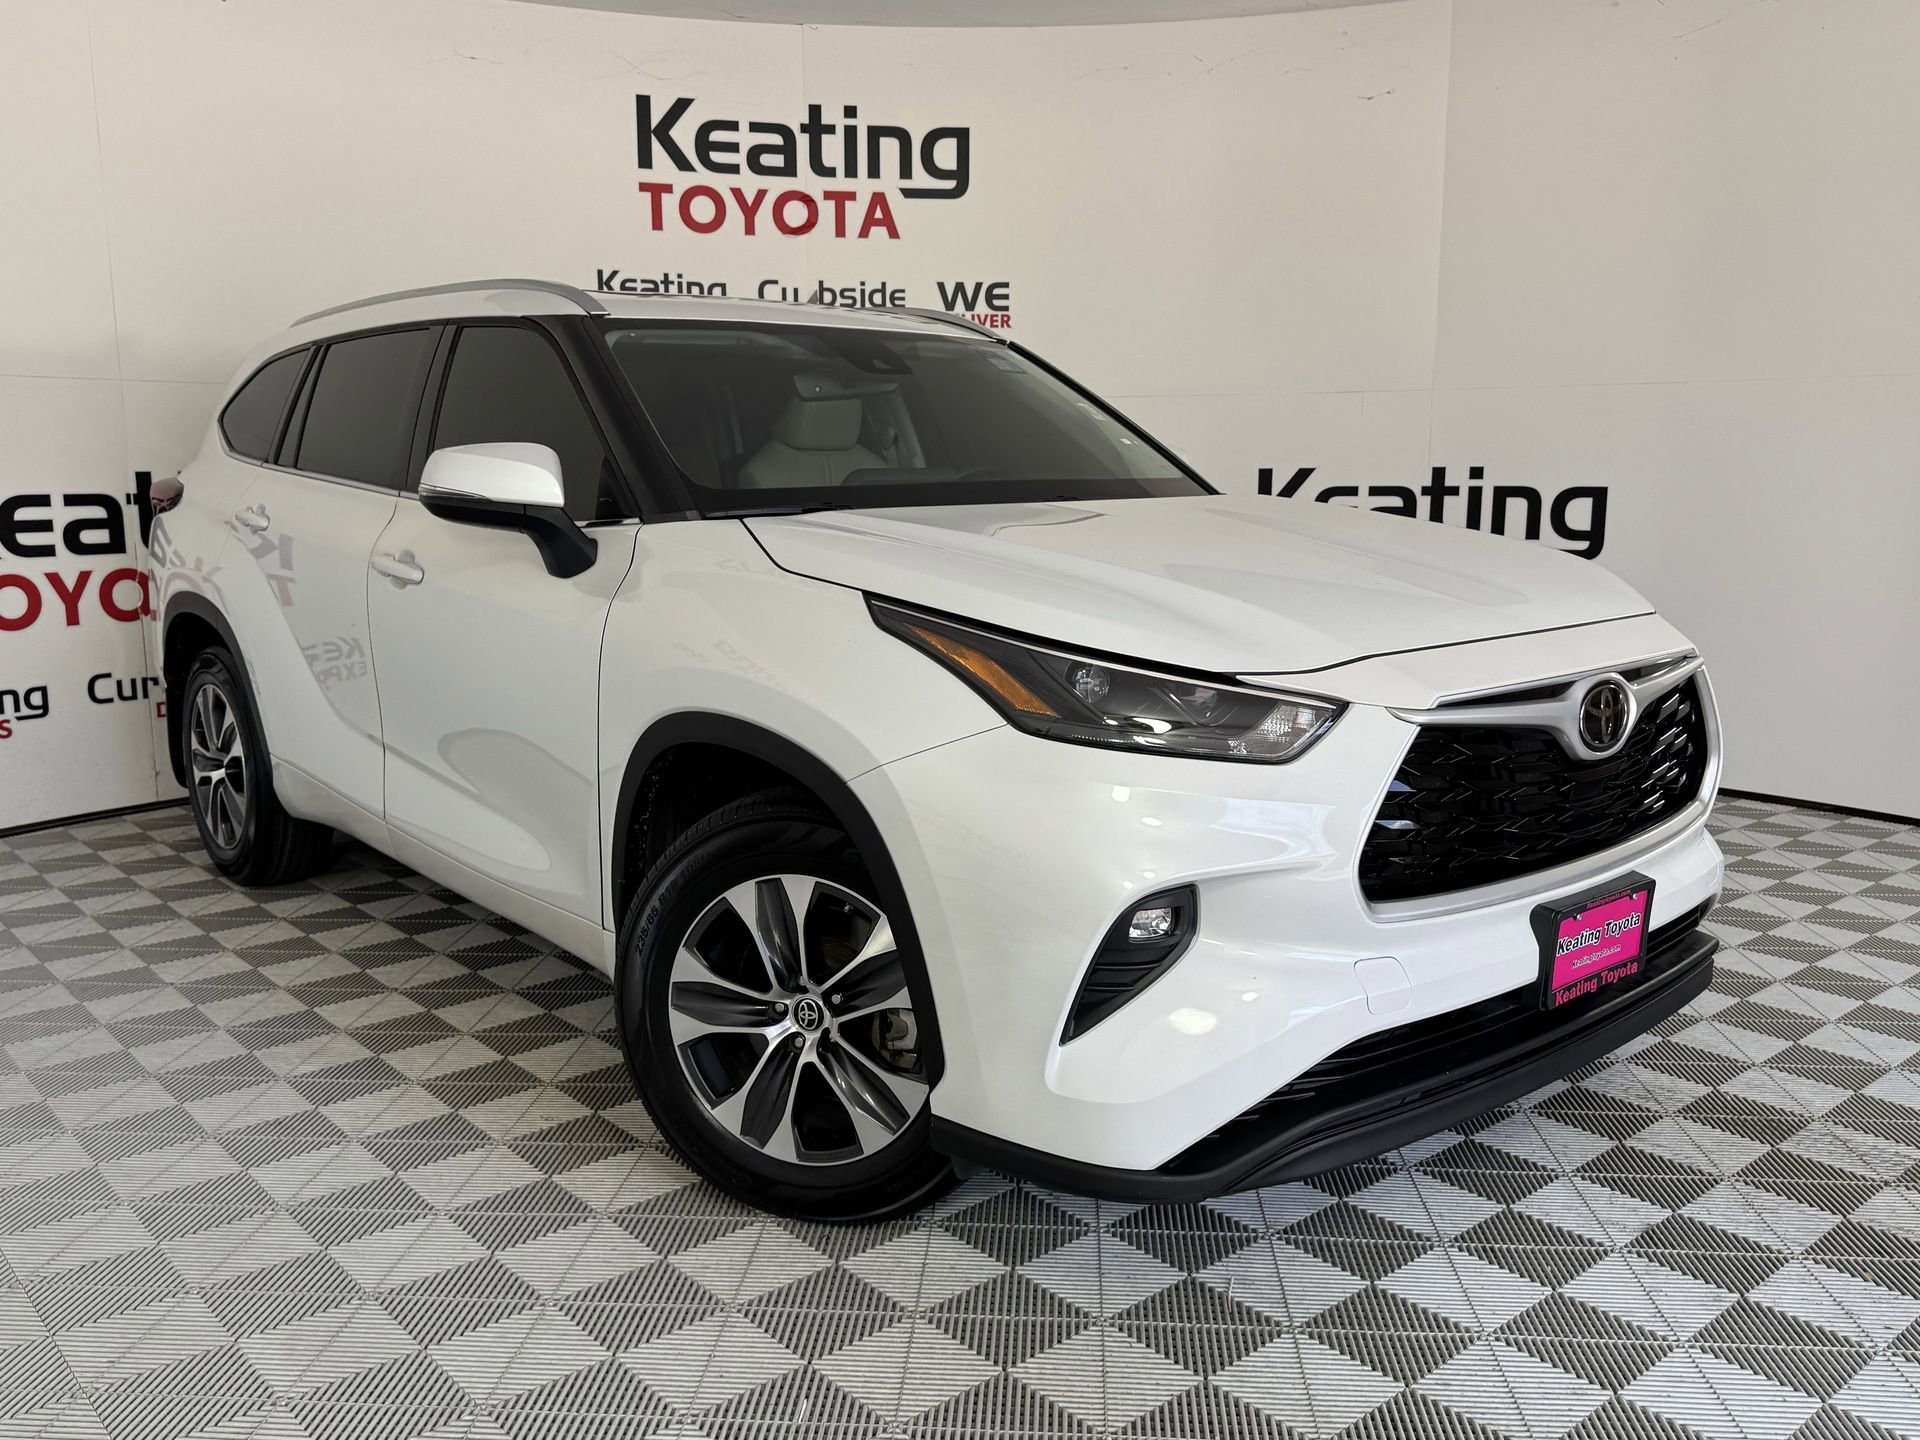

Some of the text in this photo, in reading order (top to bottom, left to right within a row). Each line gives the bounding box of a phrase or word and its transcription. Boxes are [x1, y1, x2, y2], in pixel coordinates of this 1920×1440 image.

[635, 94, 970, 199] Keating
[638, 182, 900, 239] TOYOTA
[936, 282, 1010, 312] WE
[1556, 912, 1641, 957] Keating Toyota
[1555, 961, 1638, 1006] Keating Toyota
